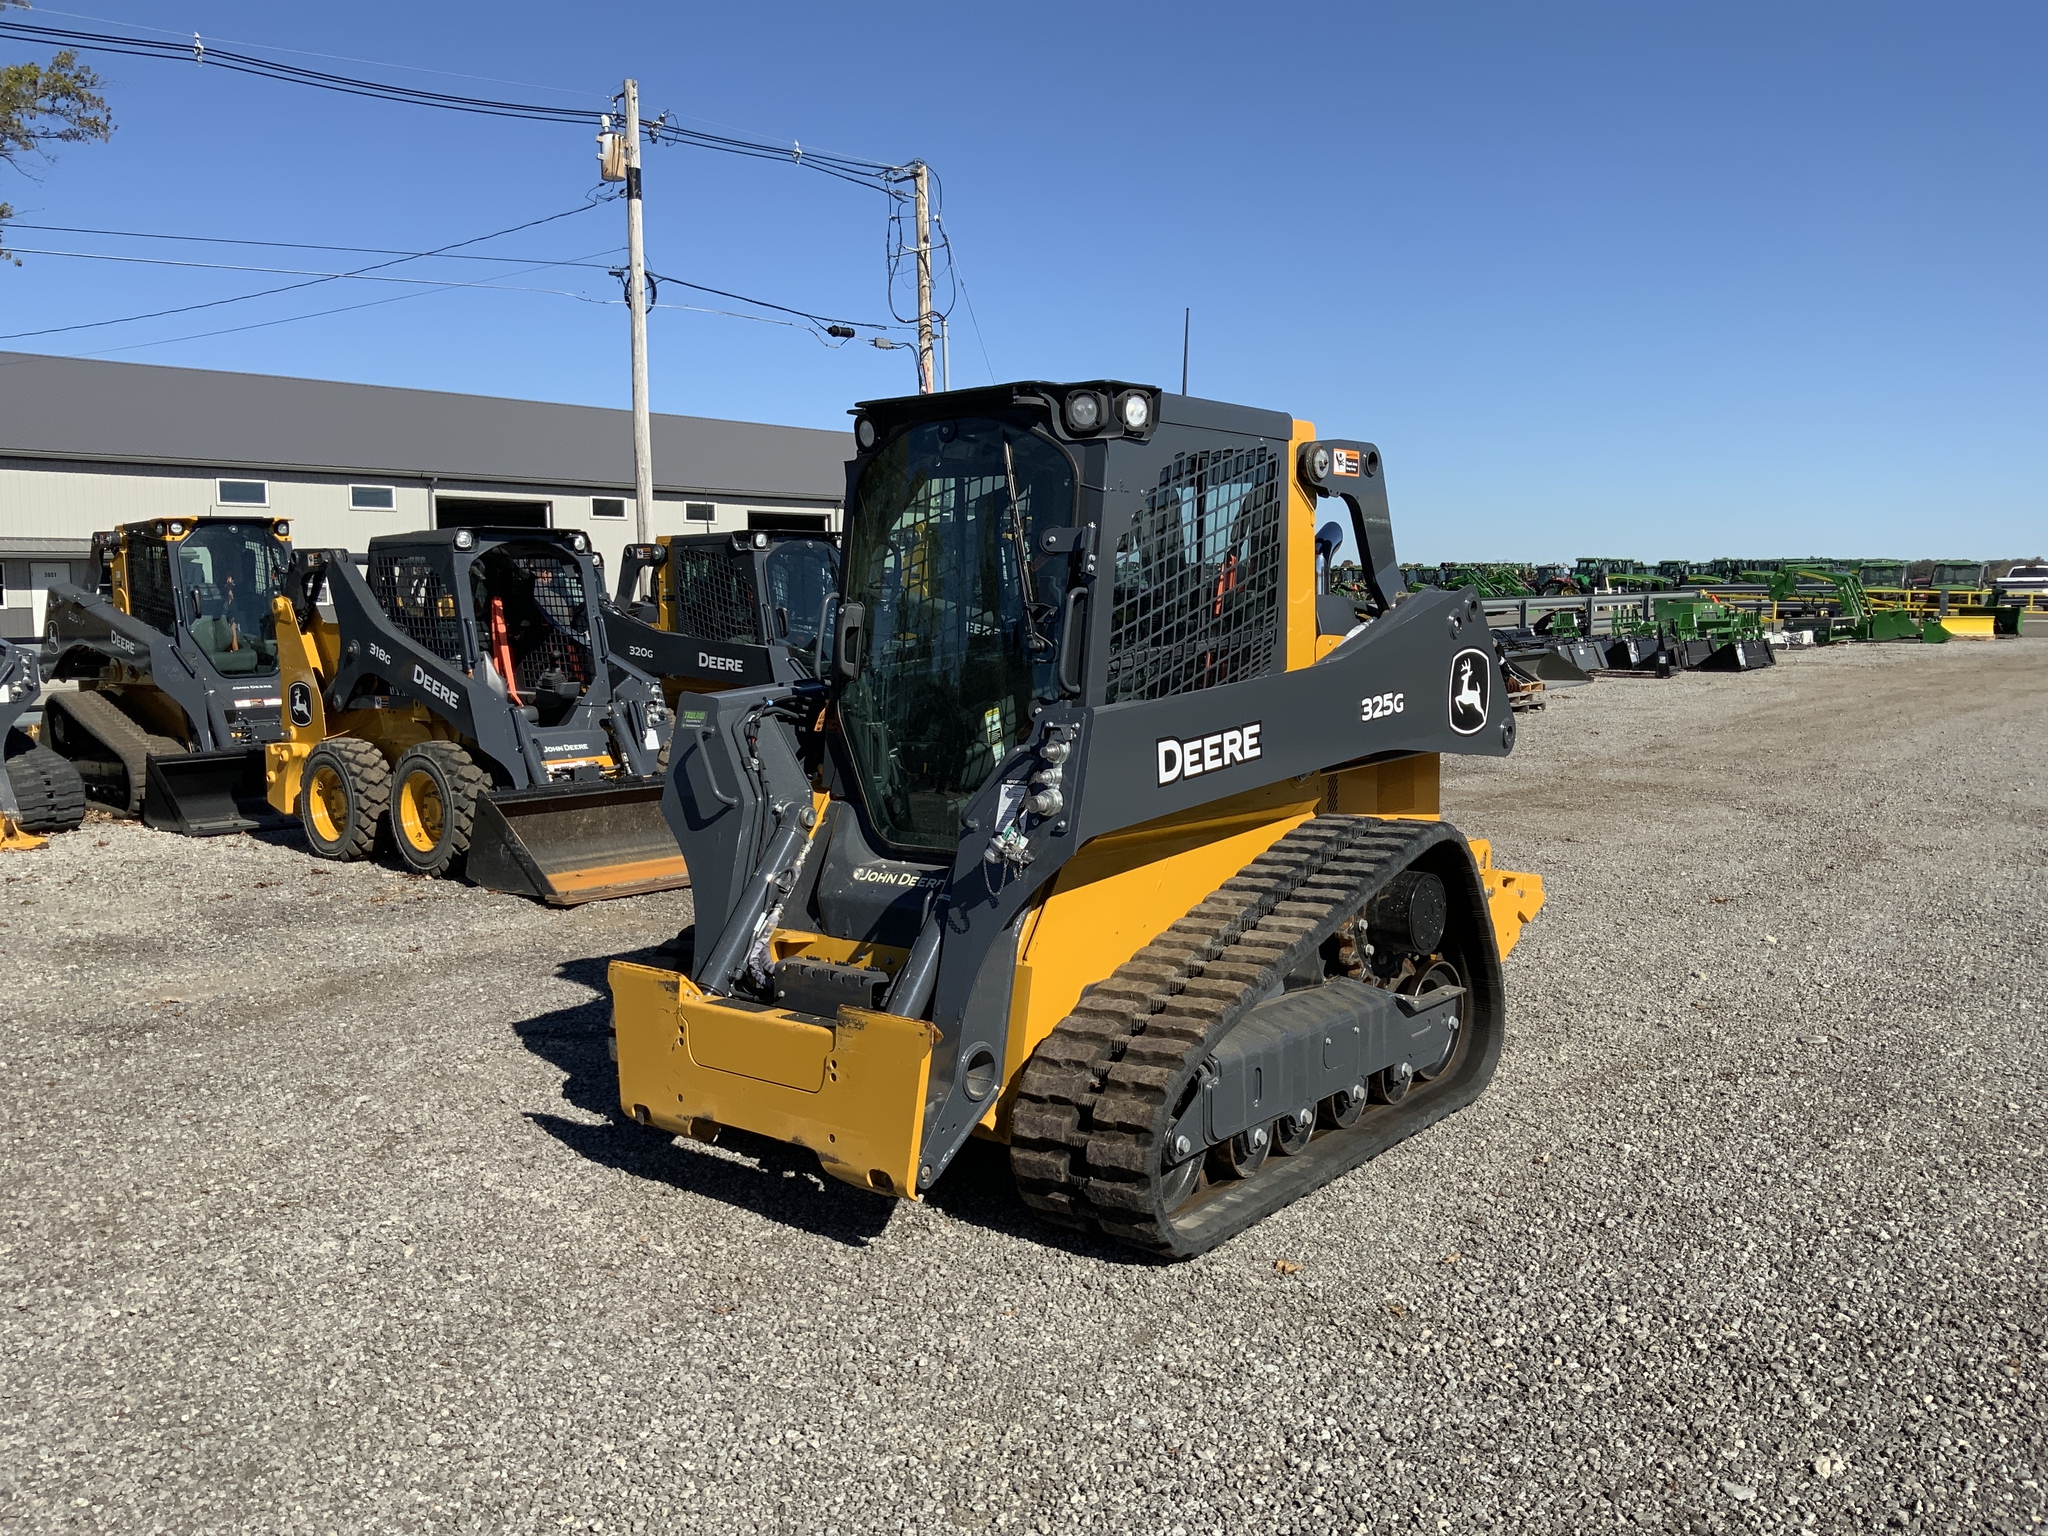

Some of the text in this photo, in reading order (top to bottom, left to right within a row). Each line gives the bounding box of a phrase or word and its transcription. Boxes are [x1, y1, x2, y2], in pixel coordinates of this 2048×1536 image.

[111, 629, 135, 655] DEERE
[369, 642, 392, 666] 318G
[629, 645, 654, 659] 320G
[698, 651, 744, 673] DEERE
[413, 663, 460, 710] DEERE
[1361, 692, 1405, 722] 325G
[543, 743, 589, 753] JOHN DEERE
[1157, 723, 1262, 786] DEERE
[860, 869, 898, 885] JOHN
